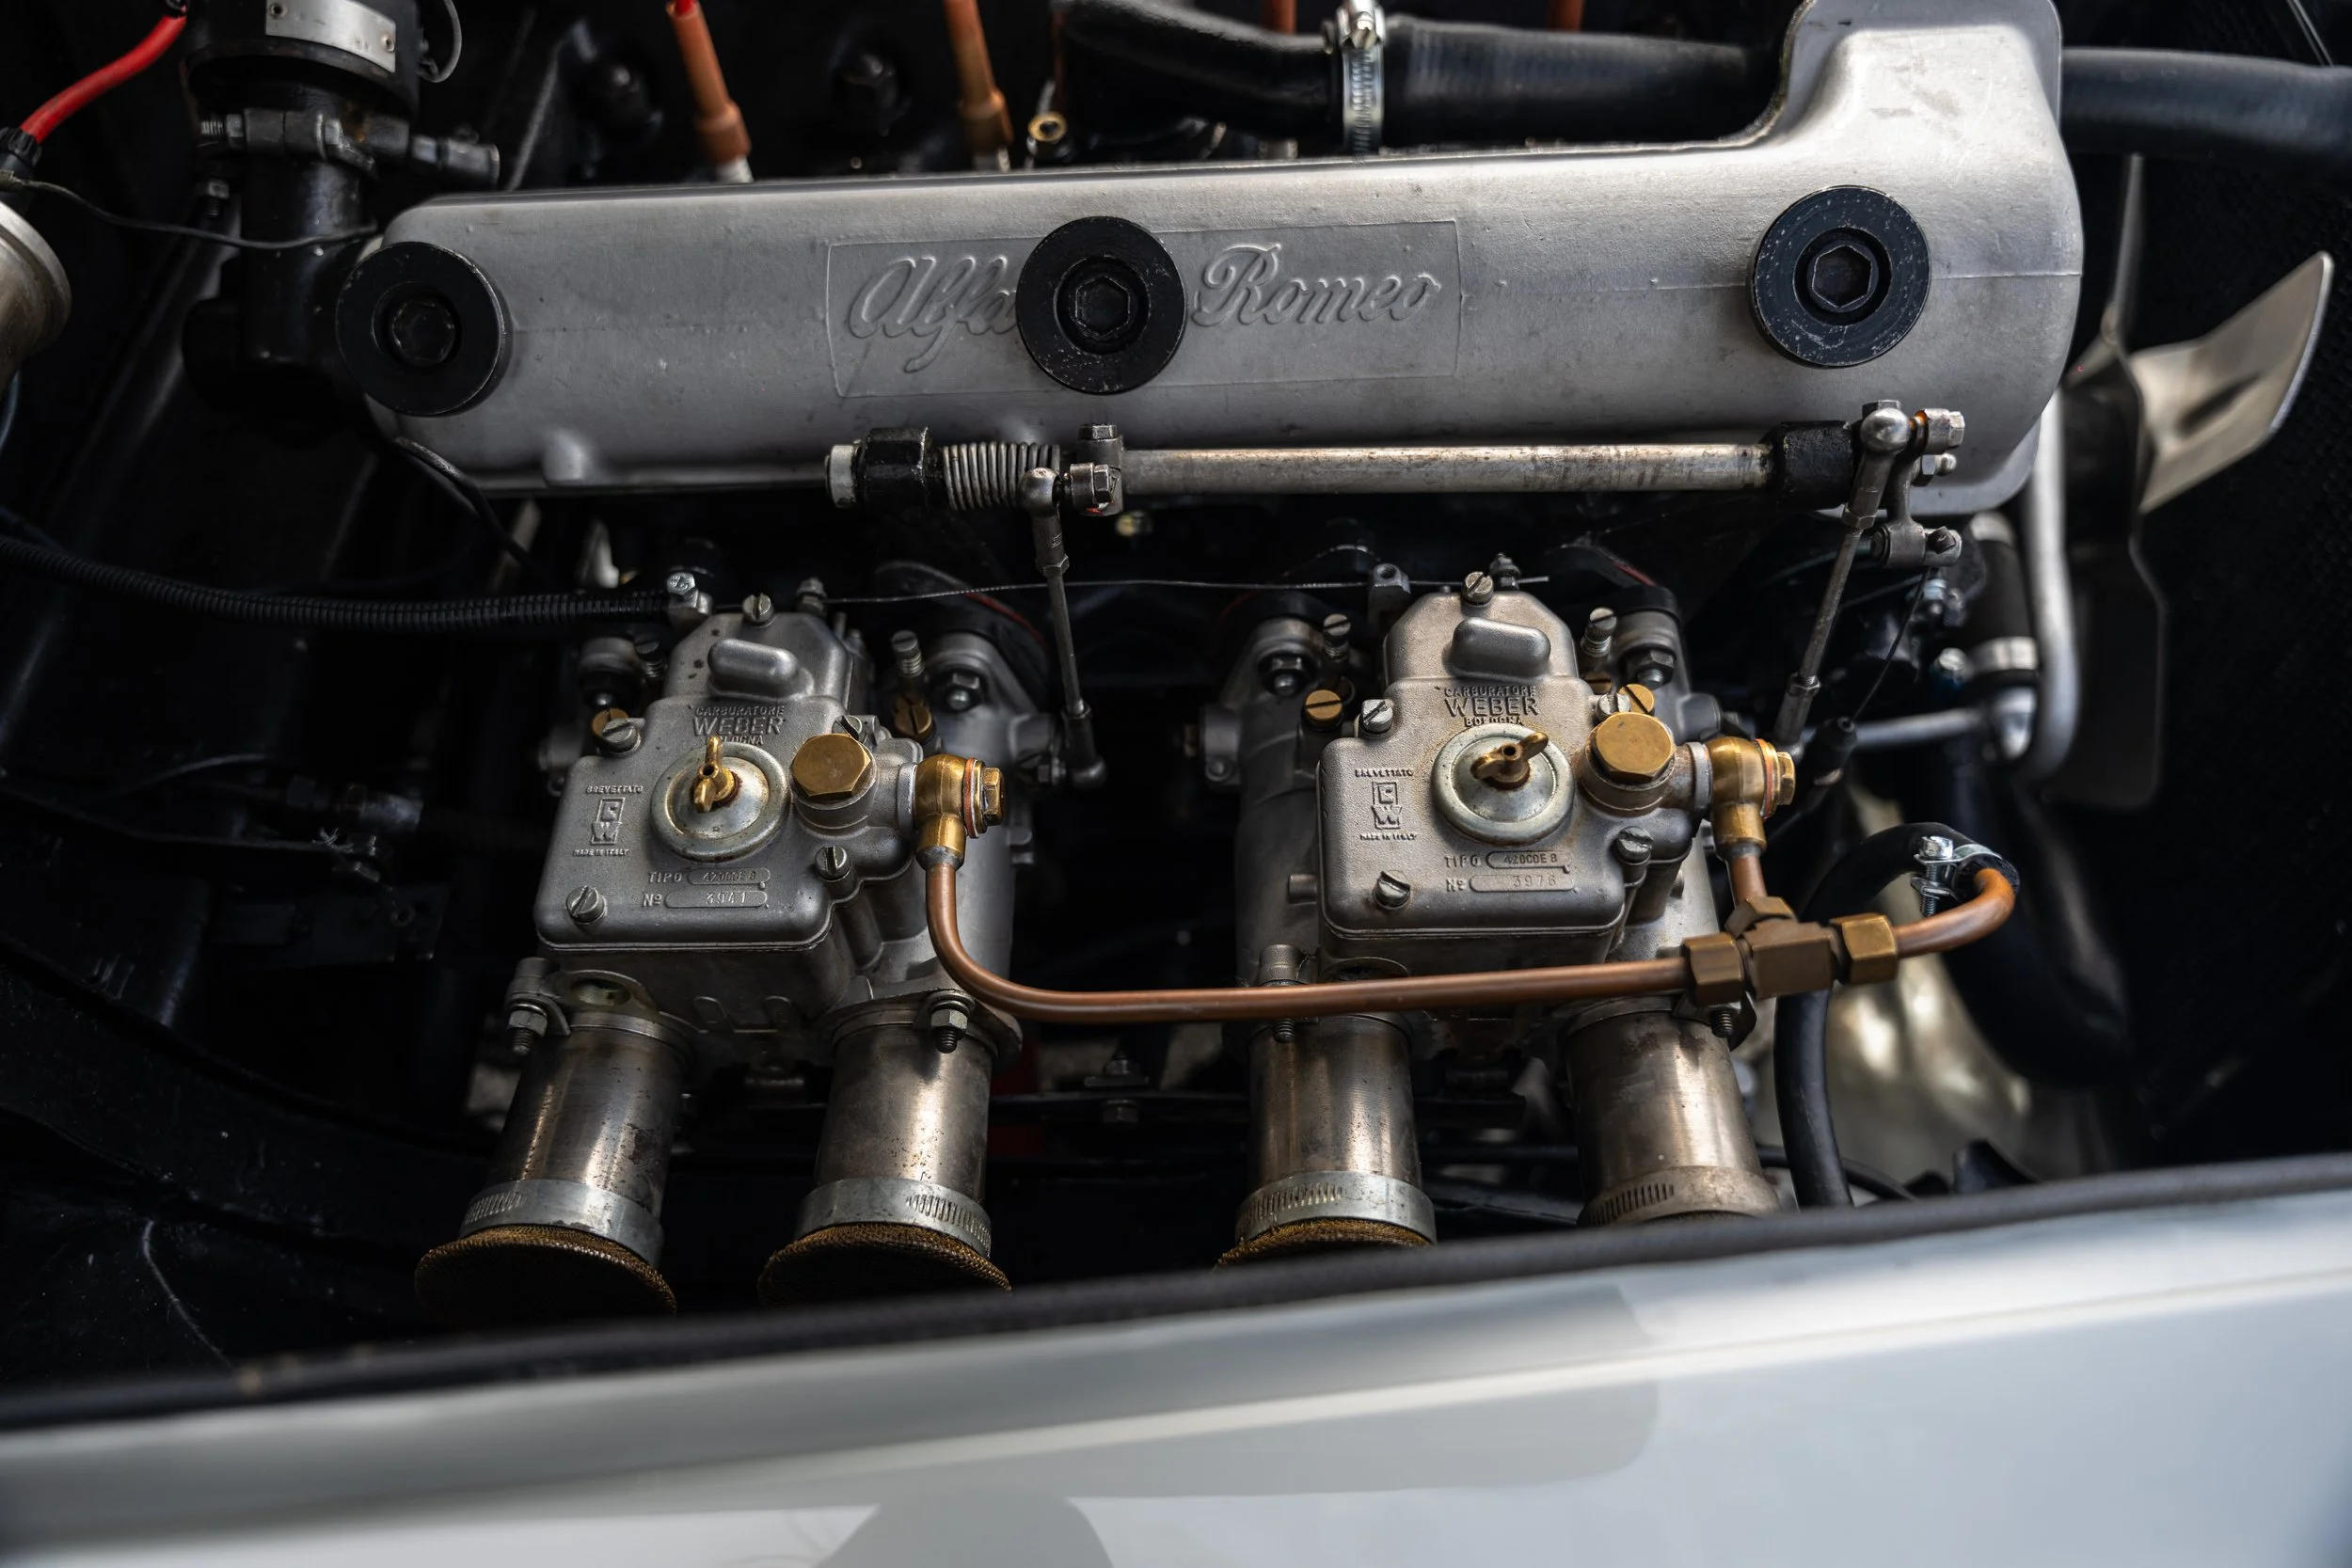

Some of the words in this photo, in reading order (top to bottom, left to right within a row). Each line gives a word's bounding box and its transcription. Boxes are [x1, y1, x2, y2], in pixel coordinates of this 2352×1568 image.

[849, 255, 1017, 373] Alfa
[1191, 243, 1441, 326] Romeo
[1444, 686, 1537, 698] CARBURATORE
[695, 705, 785, 717] CARBURATORE
[1444, 697, 1539, 717] WEBER
[692, 717, 784, 736] WEBER
[706, 734, 765, 746] LOGNA
[586, 784, 644, 795] BREVETTATO
[1444, 854, 1479, 867] TIPO
[648, 871, 683, 883] TIPO
[1513, 875, 1557, 888] 3976
[706, 892, 748, 904] 3941
